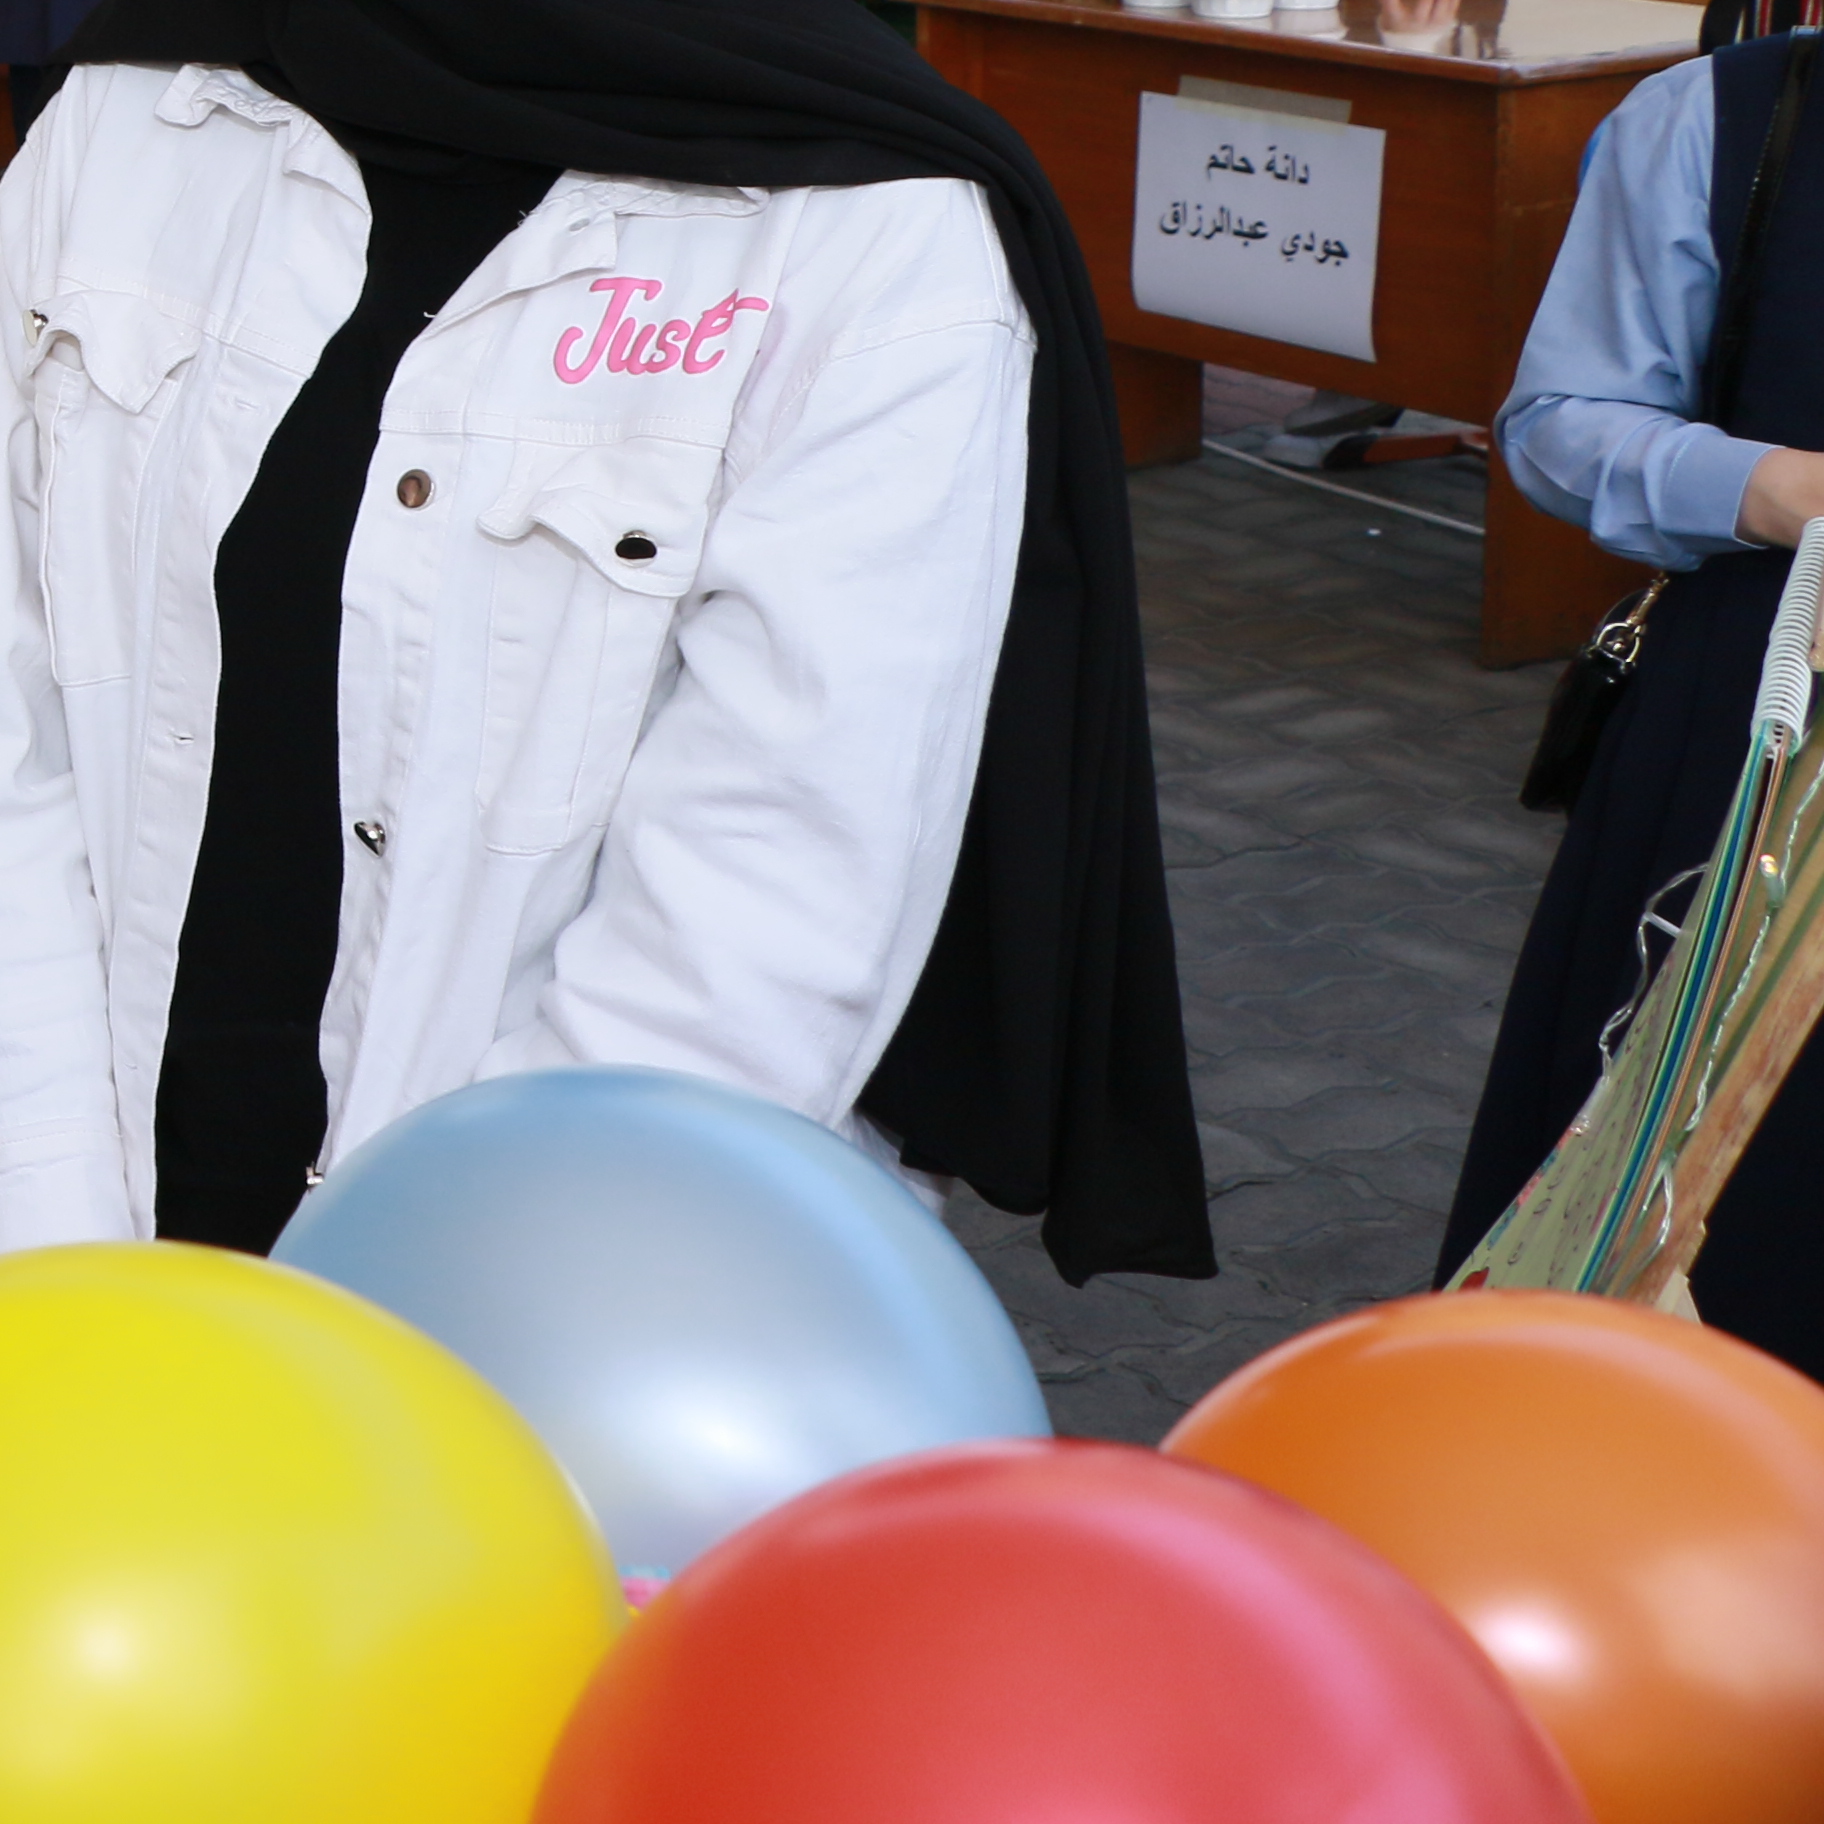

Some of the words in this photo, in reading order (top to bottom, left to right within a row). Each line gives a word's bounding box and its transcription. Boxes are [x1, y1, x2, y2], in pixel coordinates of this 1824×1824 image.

[1205, 143, 1255, 181] حاتم
[1264, 145, 1311, 185] دانة
[1159, 200, 1269, 247] عبدالرزاق
[1281, 229, 1350, 266] جودي
[555, 277, 769, 384] Just
